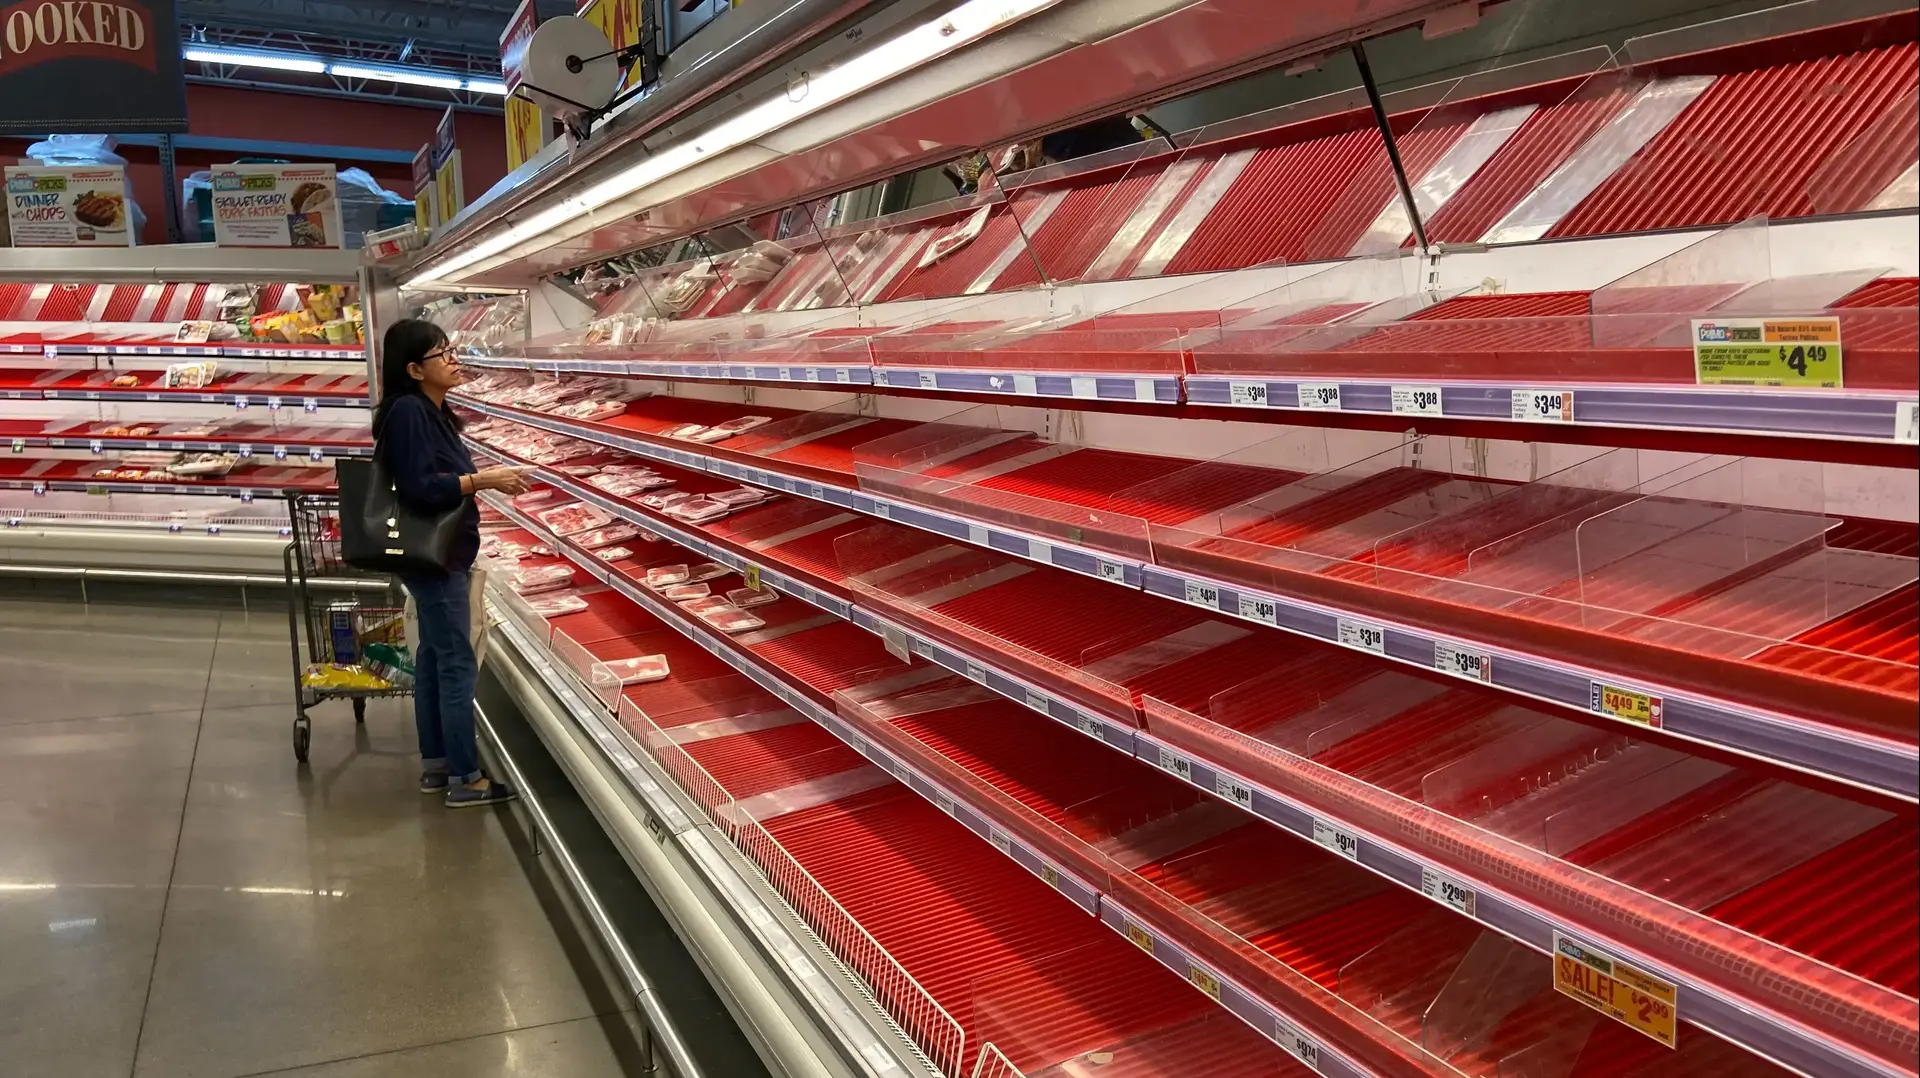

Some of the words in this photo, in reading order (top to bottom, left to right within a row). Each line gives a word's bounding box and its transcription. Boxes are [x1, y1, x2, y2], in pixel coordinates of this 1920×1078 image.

[0, 1, 145, 59] OOKED
[15, 193, 60, 208] DINNER
[215, 193, 288, 208] SKILLET-READY
[26, 207, 66, 221] CHOPS
[219, 207, 246, 219] PORK
[247, 205, 287, 217] FAJITAS
[1700, 329, 1725, 340] PRIMO
[1247, 386, 1266, 401] $388
[1317, 388, 1338, 404] $388
[1413, 391, 1437, 410] $388
[1534, 394, 1562, 415] $349
[1255, 601, 1274, 618] $439
[1360, 628, 1381, 646] $318
[1455, 652, 1480, 672] $399
[1592, 684, 1600, 712] SALE!
[1605, 692, 1633, 711] $449
[1335, 832, 1356, 851] $974
[1441, 881, 1466, 903] $299
[1560, 941, 1581, 958] PRIMO
[1560, 957, 1614, 1005] SALE!
[1631, 990, 1669, 1024] $299
[1296, 1038, 1316, 1060] $974
